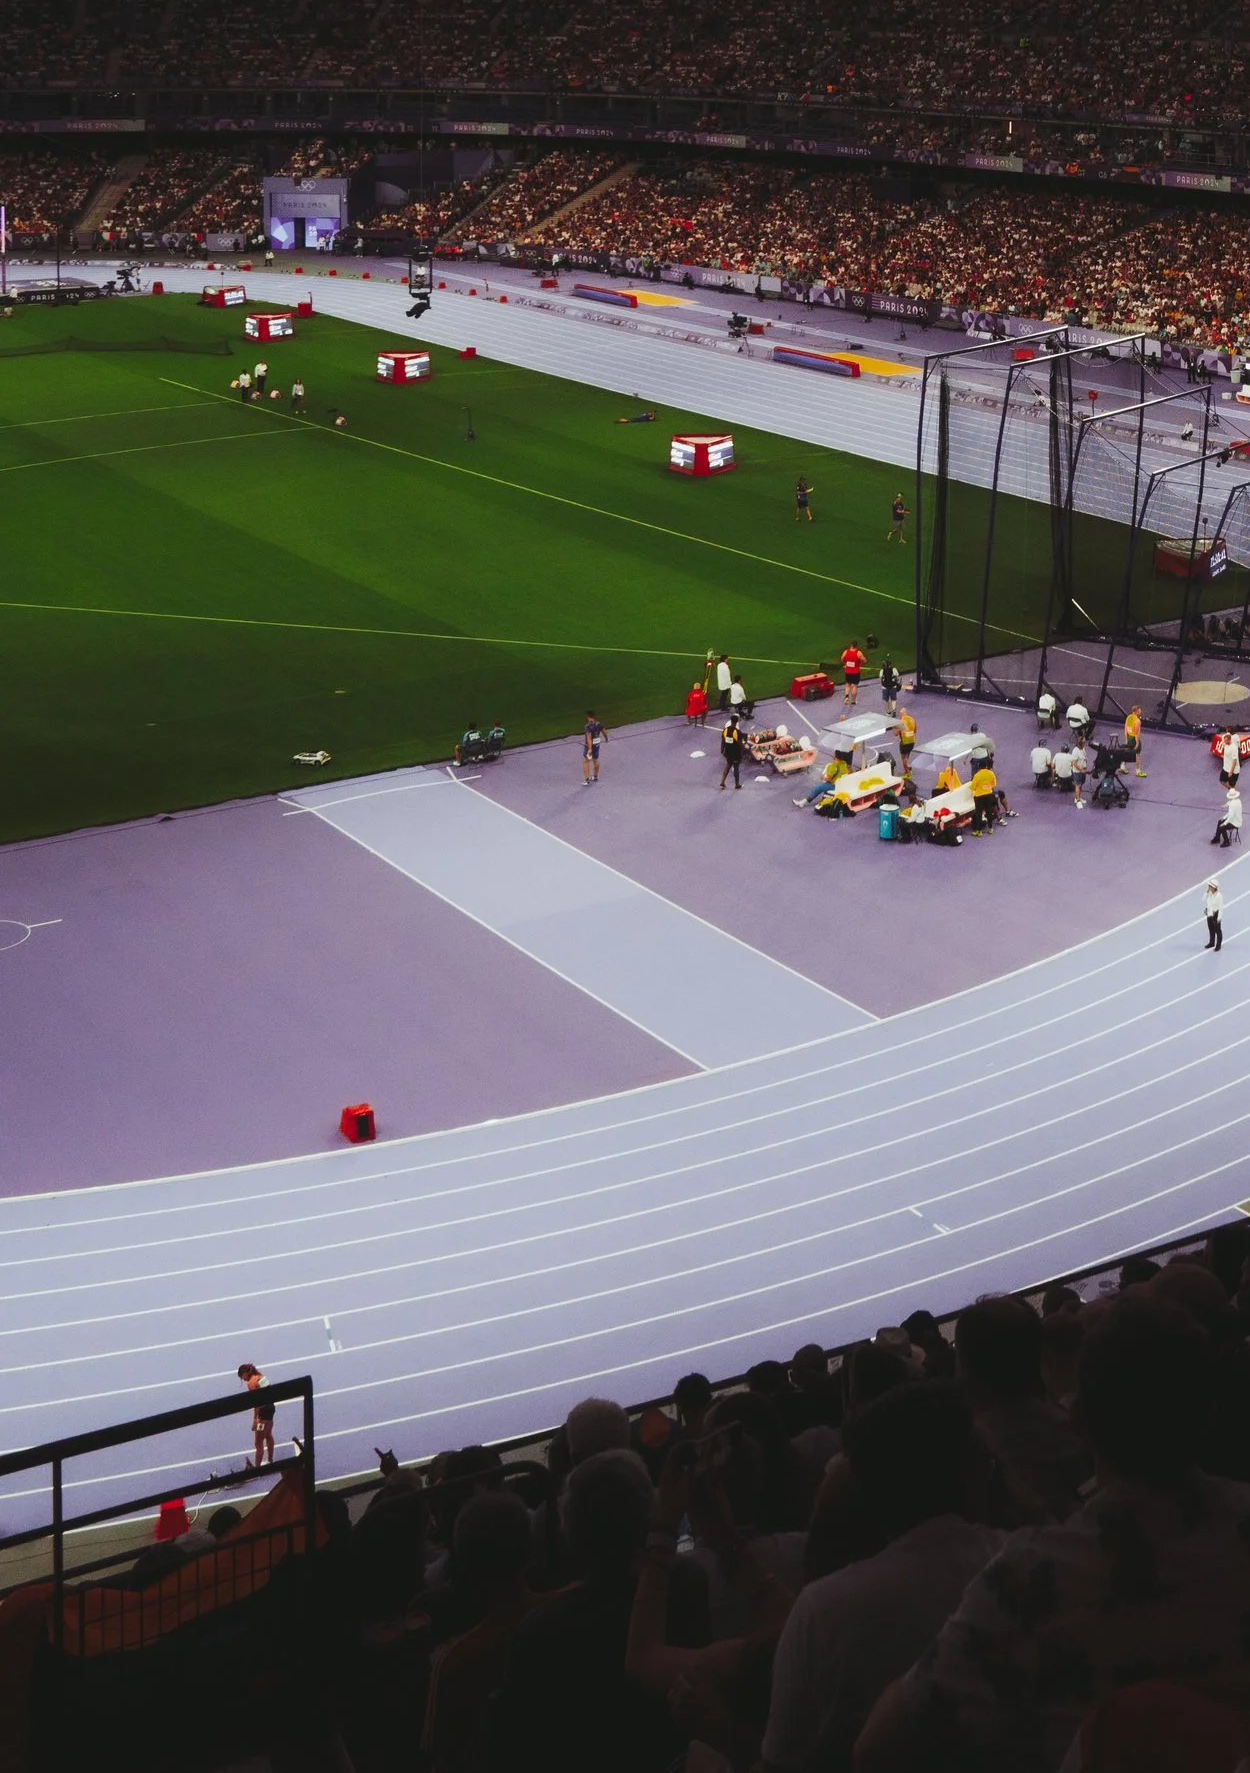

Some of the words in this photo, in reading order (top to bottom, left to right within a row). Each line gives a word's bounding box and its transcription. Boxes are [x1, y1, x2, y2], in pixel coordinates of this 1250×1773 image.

[576, 128, 595, 136] PARIS
[597, 129, 614, 137] 2024
[706, 136, 724, 144] PARIS
[837, 146, 855, 154] PARIS
[855, 147, 872, 155] 2024
[975, 158, 994, 166] PARIS
[995, 159, 1013, 167] 2024
[1176, 175, 1195, 185] PARIS
[1197, 178, 1219, 187] 2024
[578, 255, 598, 264] 2024
[702, 272, 724, 284] PARIS
[880, 300, 905, 313] PARIS
